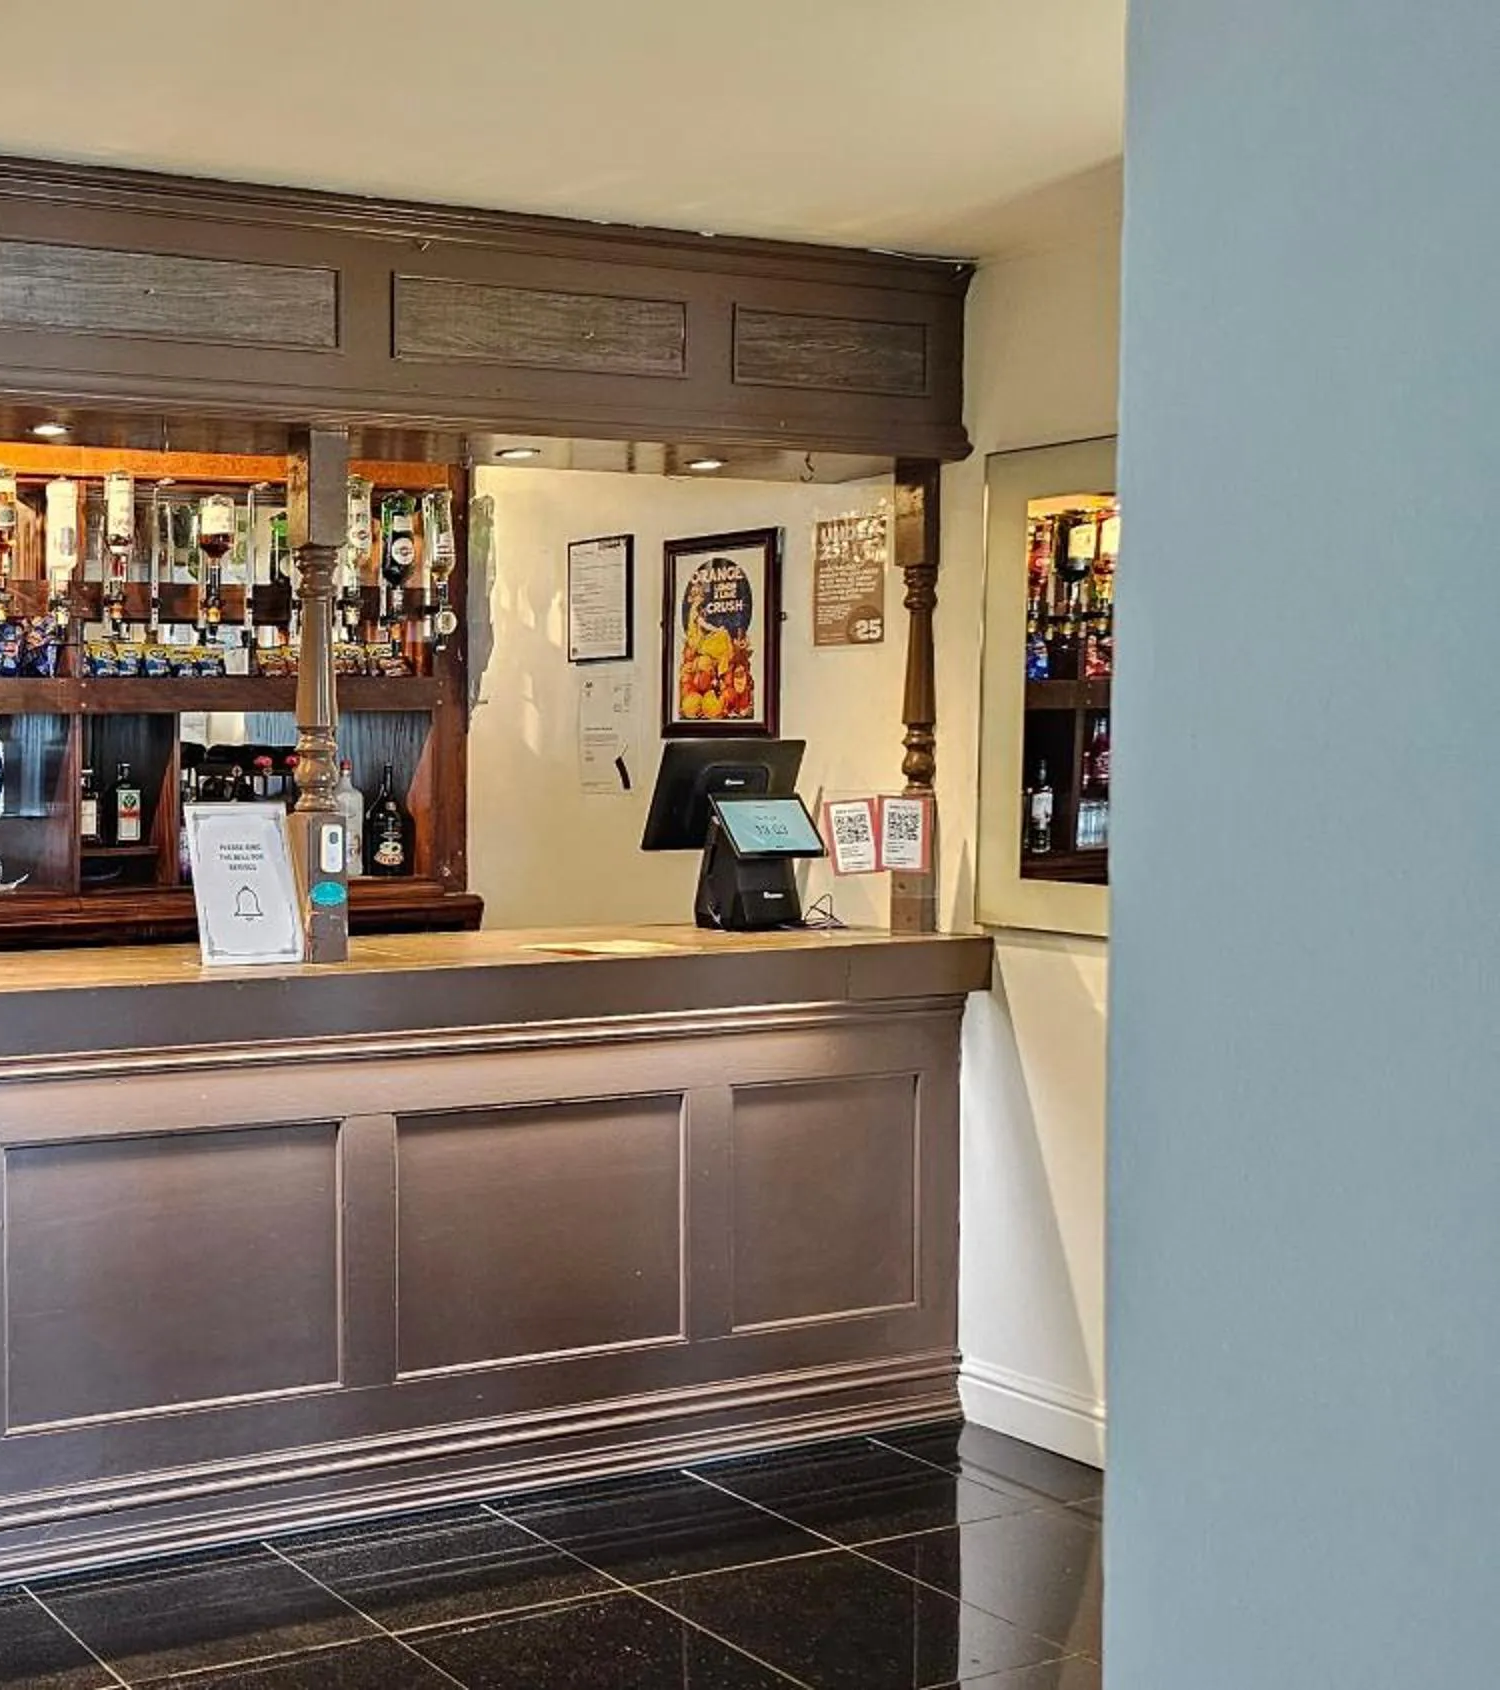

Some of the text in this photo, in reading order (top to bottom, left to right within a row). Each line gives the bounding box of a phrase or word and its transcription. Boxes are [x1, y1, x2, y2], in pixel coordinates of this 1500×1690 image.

[691, 566, 745, 584] ORANGE
[706, 599, 743, 614] CRUSH
[855, 618, 882, 640] 25
